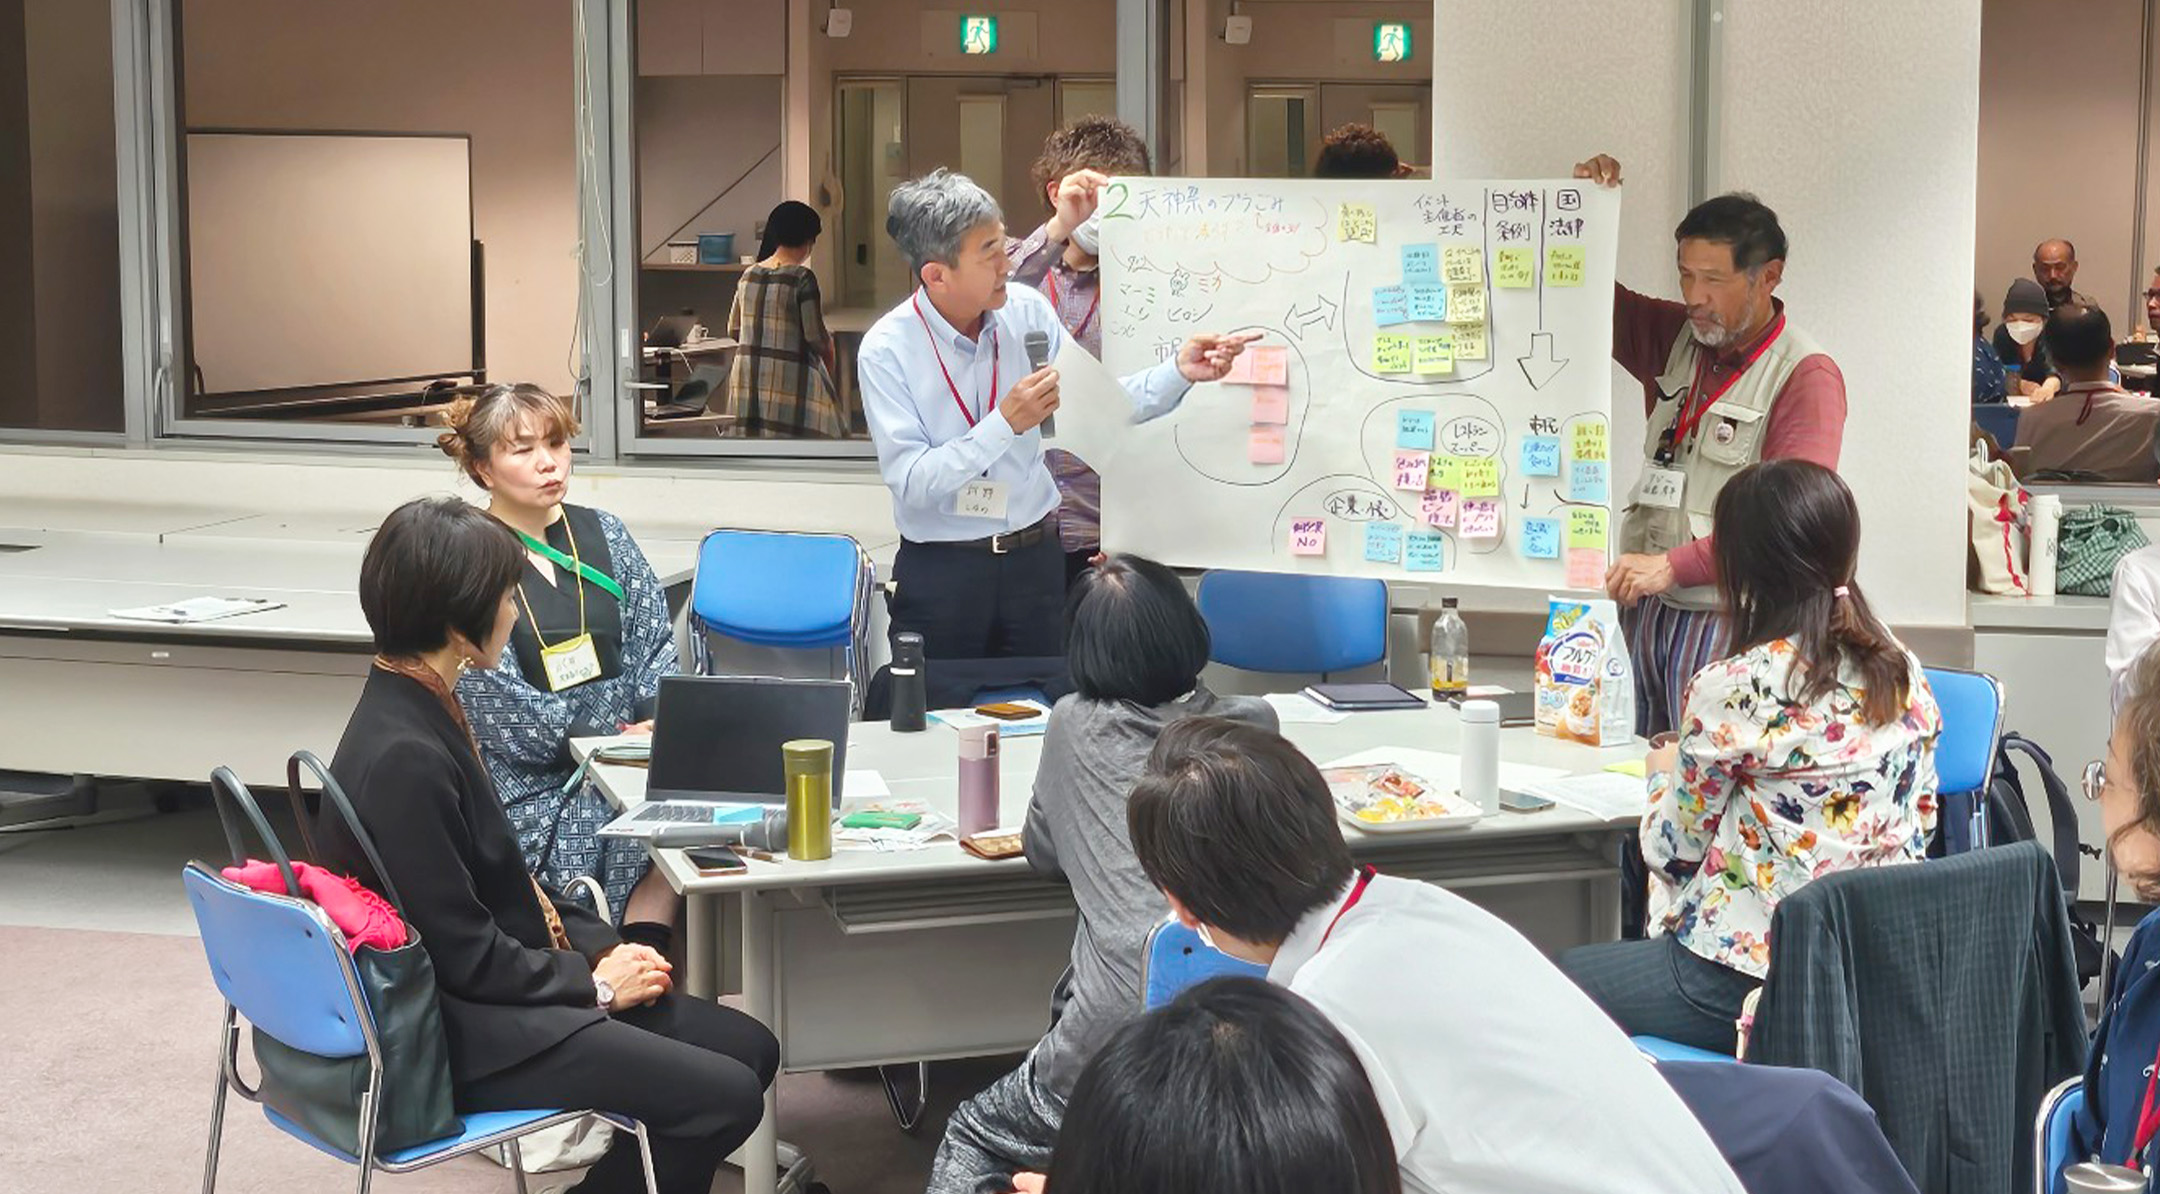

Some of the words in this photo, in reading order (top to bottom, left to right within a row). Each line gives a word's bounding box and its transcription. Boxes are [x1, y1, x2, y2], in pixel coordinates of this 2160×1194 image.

[1103, 183, 1134, 220] 2
[1492, 189, 1539, 214] 自治体
[1556, 188, 1581, 212] 国
[1495, 219, 1531, 242] 条例
[1549, 217, 1585, 239] 法律
[1529, 415, 1558, 436] 市民
[1450, 441, 1489, 454] スーパー
